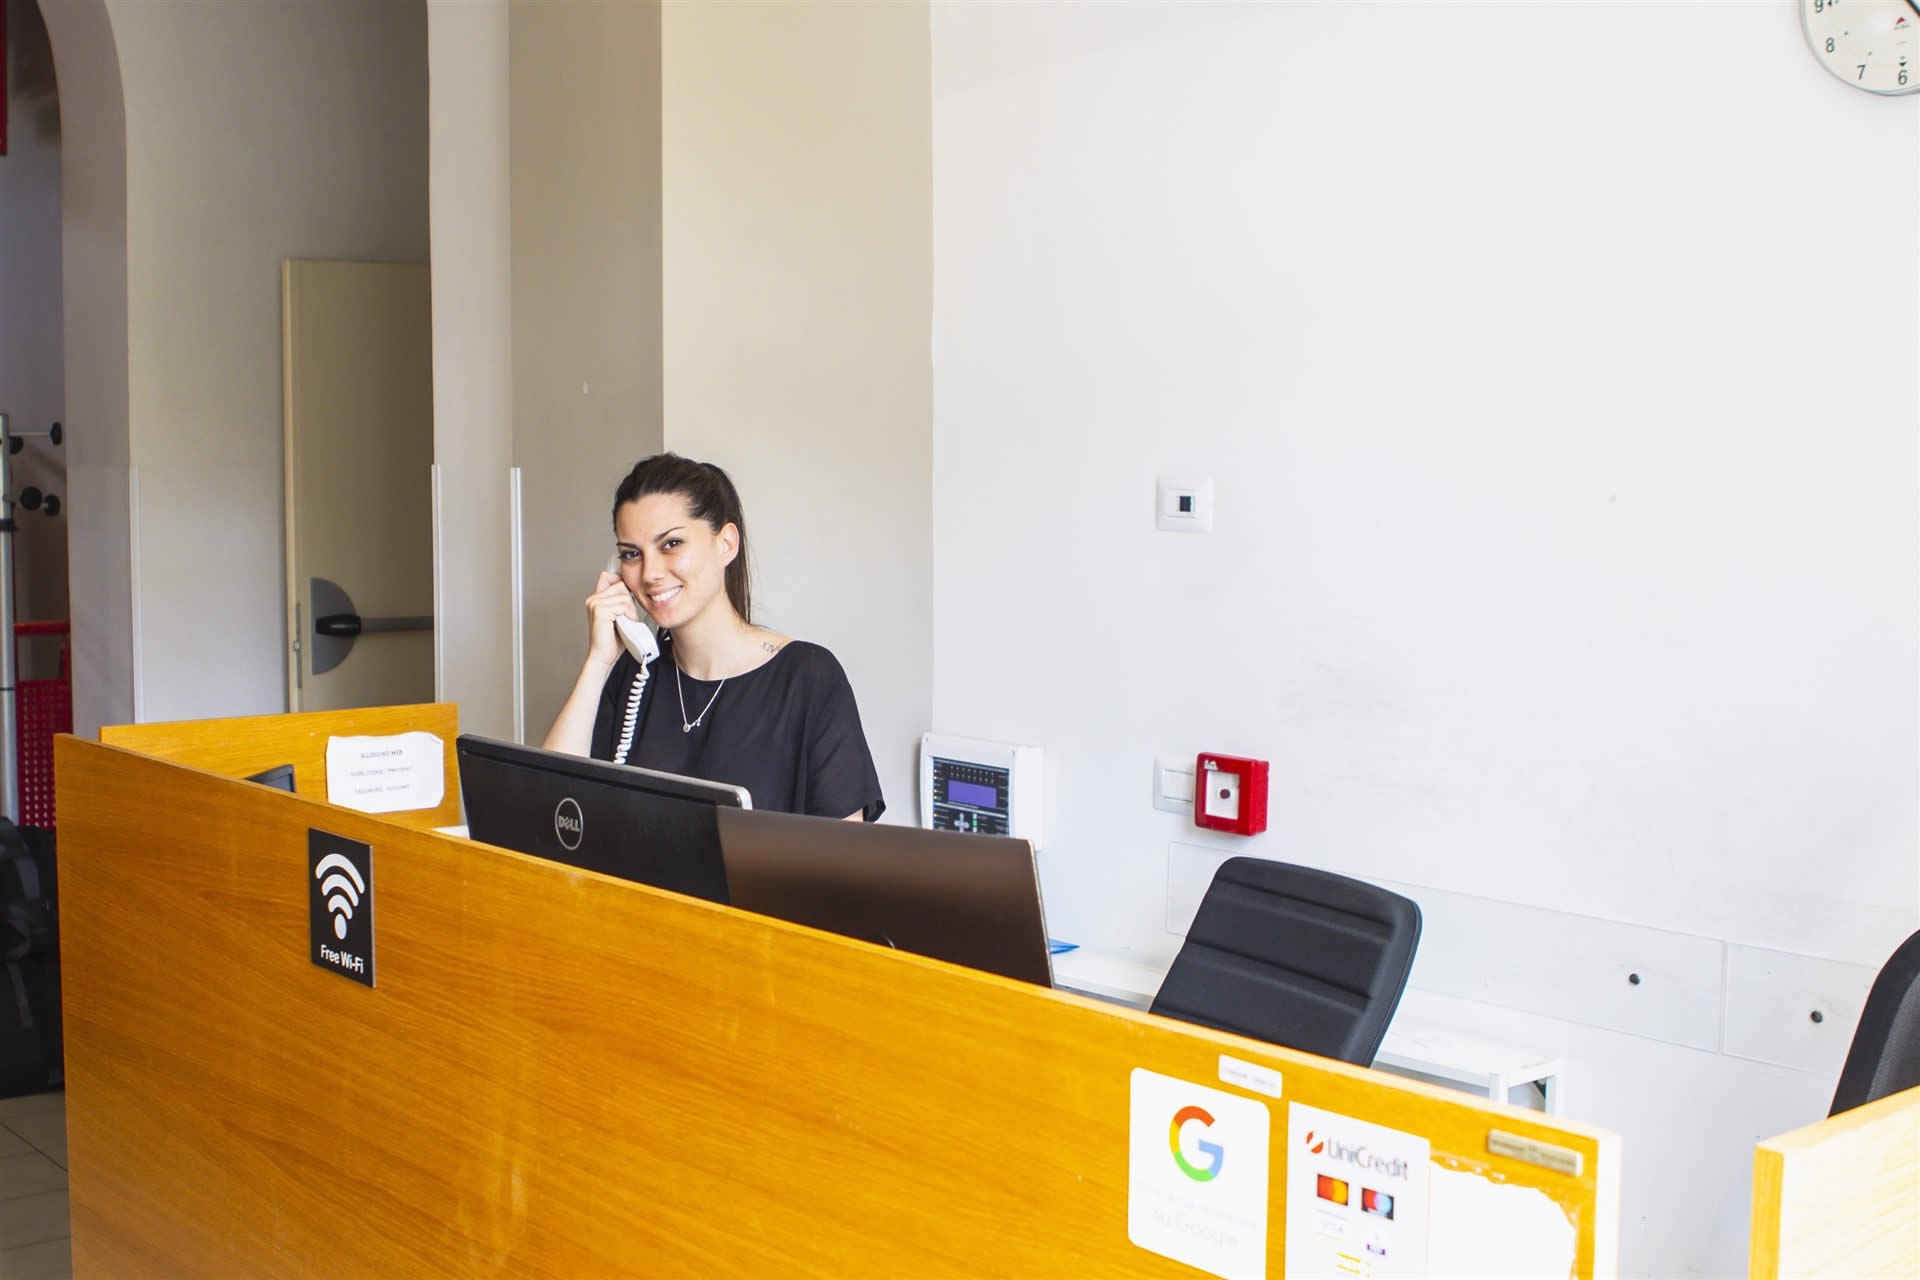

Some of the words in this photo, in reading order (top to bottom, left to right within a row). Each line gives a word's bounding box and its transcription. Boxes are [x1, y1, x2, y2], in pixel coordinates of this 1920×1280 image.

[1814, 0, 1824, 13] 9
[1825, 37, 1835, 53] 8
[1856, 64, 1866, 80] 7
[1897, 69, 1908, 85] 6
[558, 815, 580, 833] DELL
[320, 944, 340, 964] Free
[340, 950, 364, 974] Wi-Fi
[1327, 1136, 1409, 1181] UniCredit
